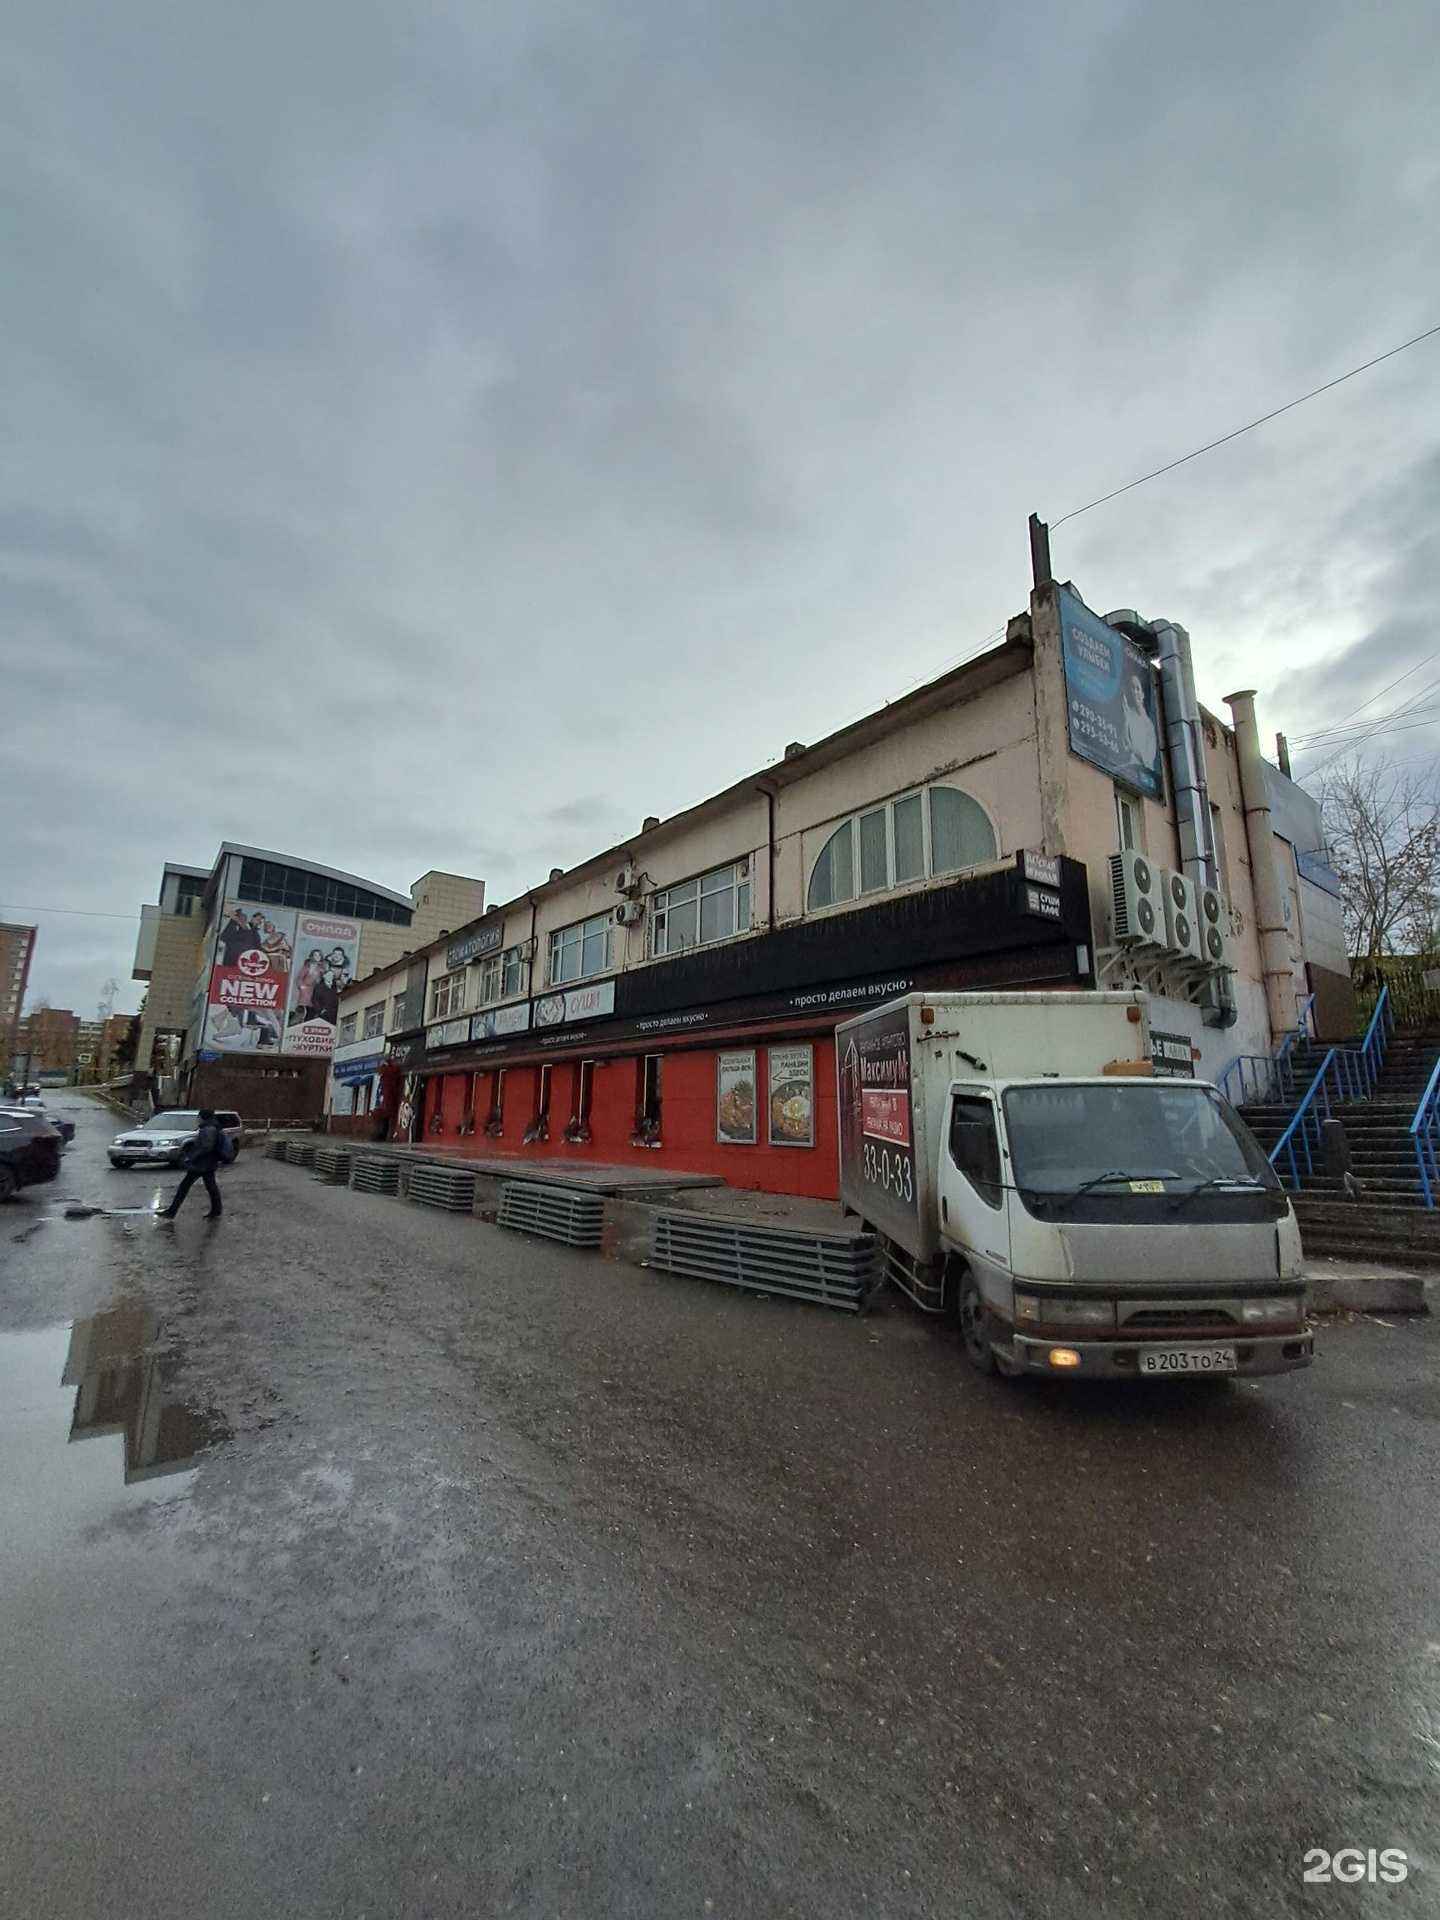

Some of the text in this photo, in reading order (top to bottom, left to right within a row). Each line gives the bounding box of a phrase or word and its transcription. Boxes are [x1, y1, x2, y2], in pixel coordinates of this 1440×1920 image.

[219, 978, 280, 1000] NEW
[219, 995, 277, 1008] COLLECTION
[795, 980, 906, 1008] просто делаем вкусно
[863, 1143, 912, 1203] 33-0-33
